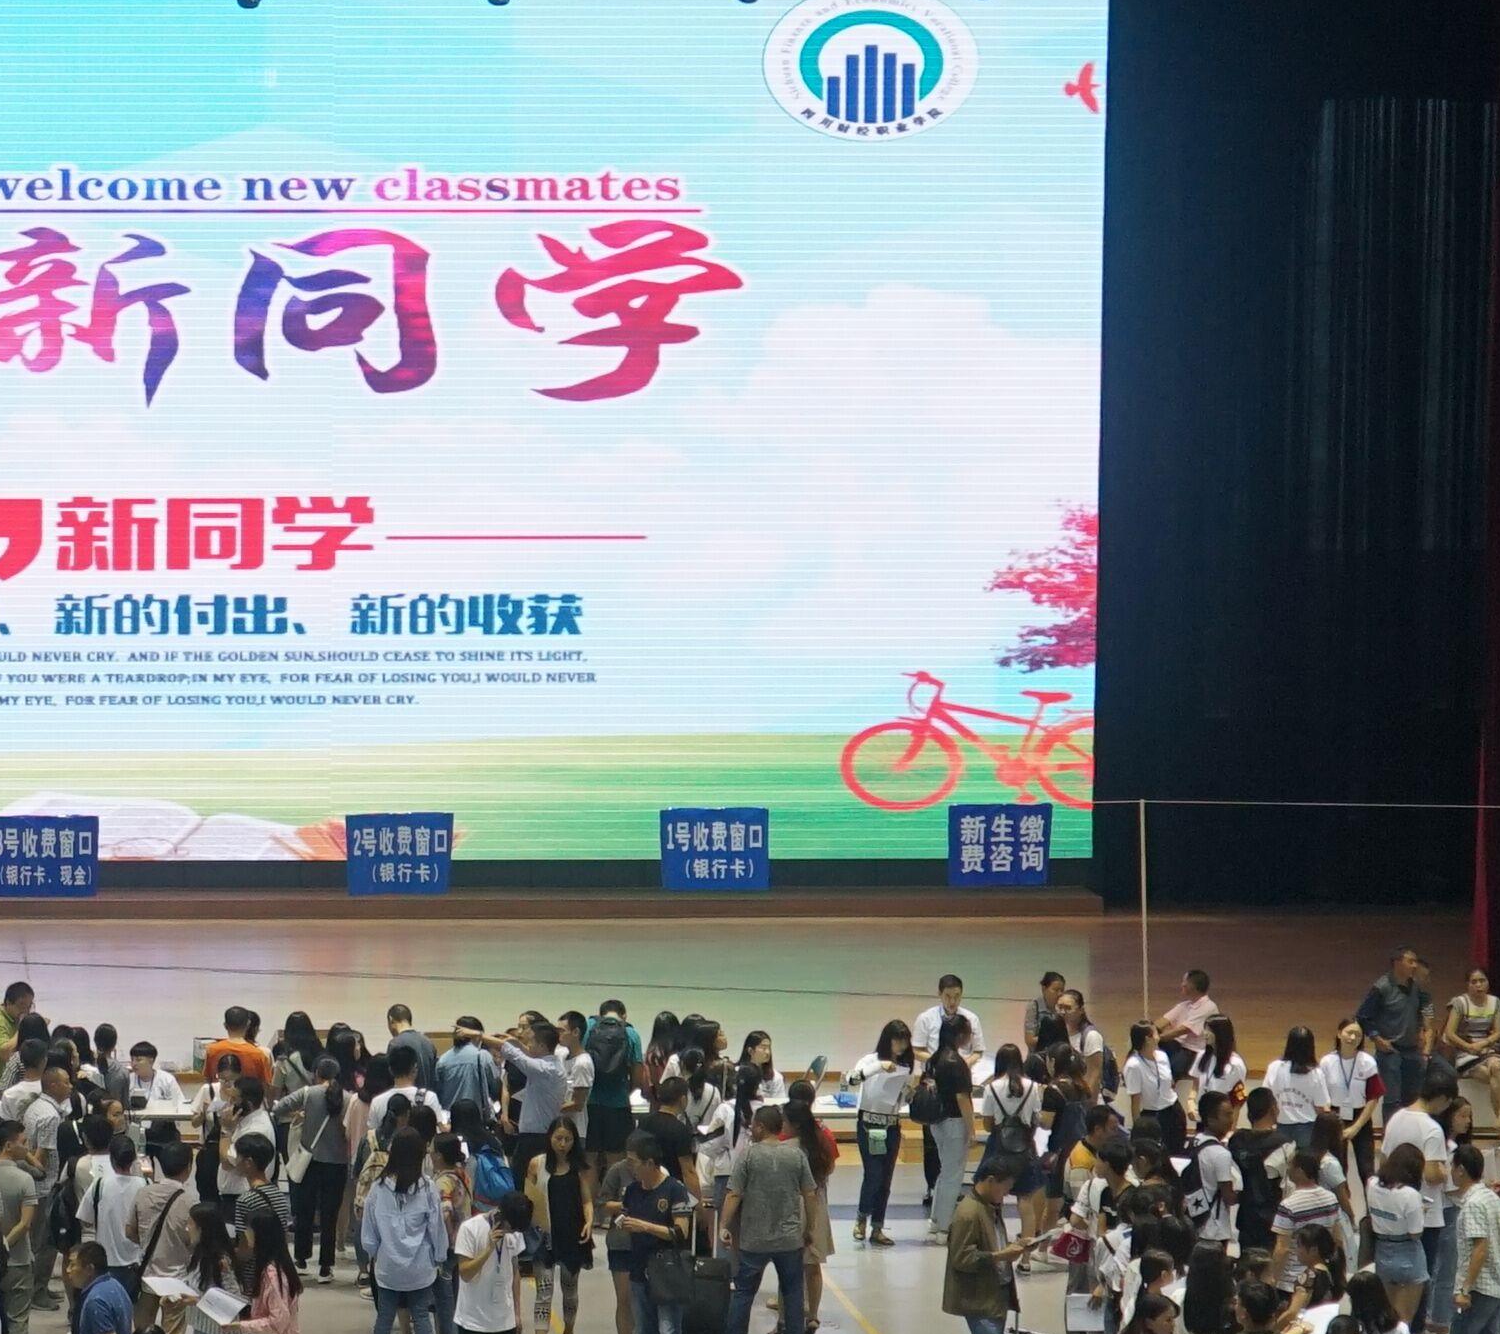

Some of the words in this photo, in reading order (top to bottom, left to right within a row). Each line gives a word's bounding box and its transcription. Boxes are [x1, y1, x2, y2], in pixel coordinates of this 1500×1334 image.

[243, 177, 357, 202] new
[374, 169, 681, 202] classmates
[32, 651, 82, 663] NEVER
[128, 651, 160, 663] AND
[165, 651, 178, 663] IF
[183, 651, 213, 663] THE
[218, 651, 279, 663] GOLDEN
[383, 651, 430, 663] CEASE
[436, 651, 455, 663] TO
[460, 651, 505, 663] SHINE
[7, 673, 37, 684] YOU
[42, 673, 86, 684] WERE
[91, 673, 101, 684] A
[213, 673, 235, 684] MY
[280, 673, 309, 684] FOR
[315, 673, 353, 684] FEAR
[358, 673, 376, 684] OF
[382, 673, 436, 684] LOSING
[485, 673, 541, 684] WOULD
[546, 673, 596, 684] NEVER
[65, 695, 95, 706] FOR
[99, 695, 138, 706] FEAR
[143, 695, 162, 706] OF
[167, 695, 221, 706] LOSING
[270, 695, 326, 706] WOULD
[332, 695, 381, 706] NEVER
[353, 826, 449, 858] 2号收费窗口
[666, 821, 763, 852] 1号收费窗口
[960, 814, 1046, 844] 新生缴
[960, 844, 1045, 873] 费咨询
